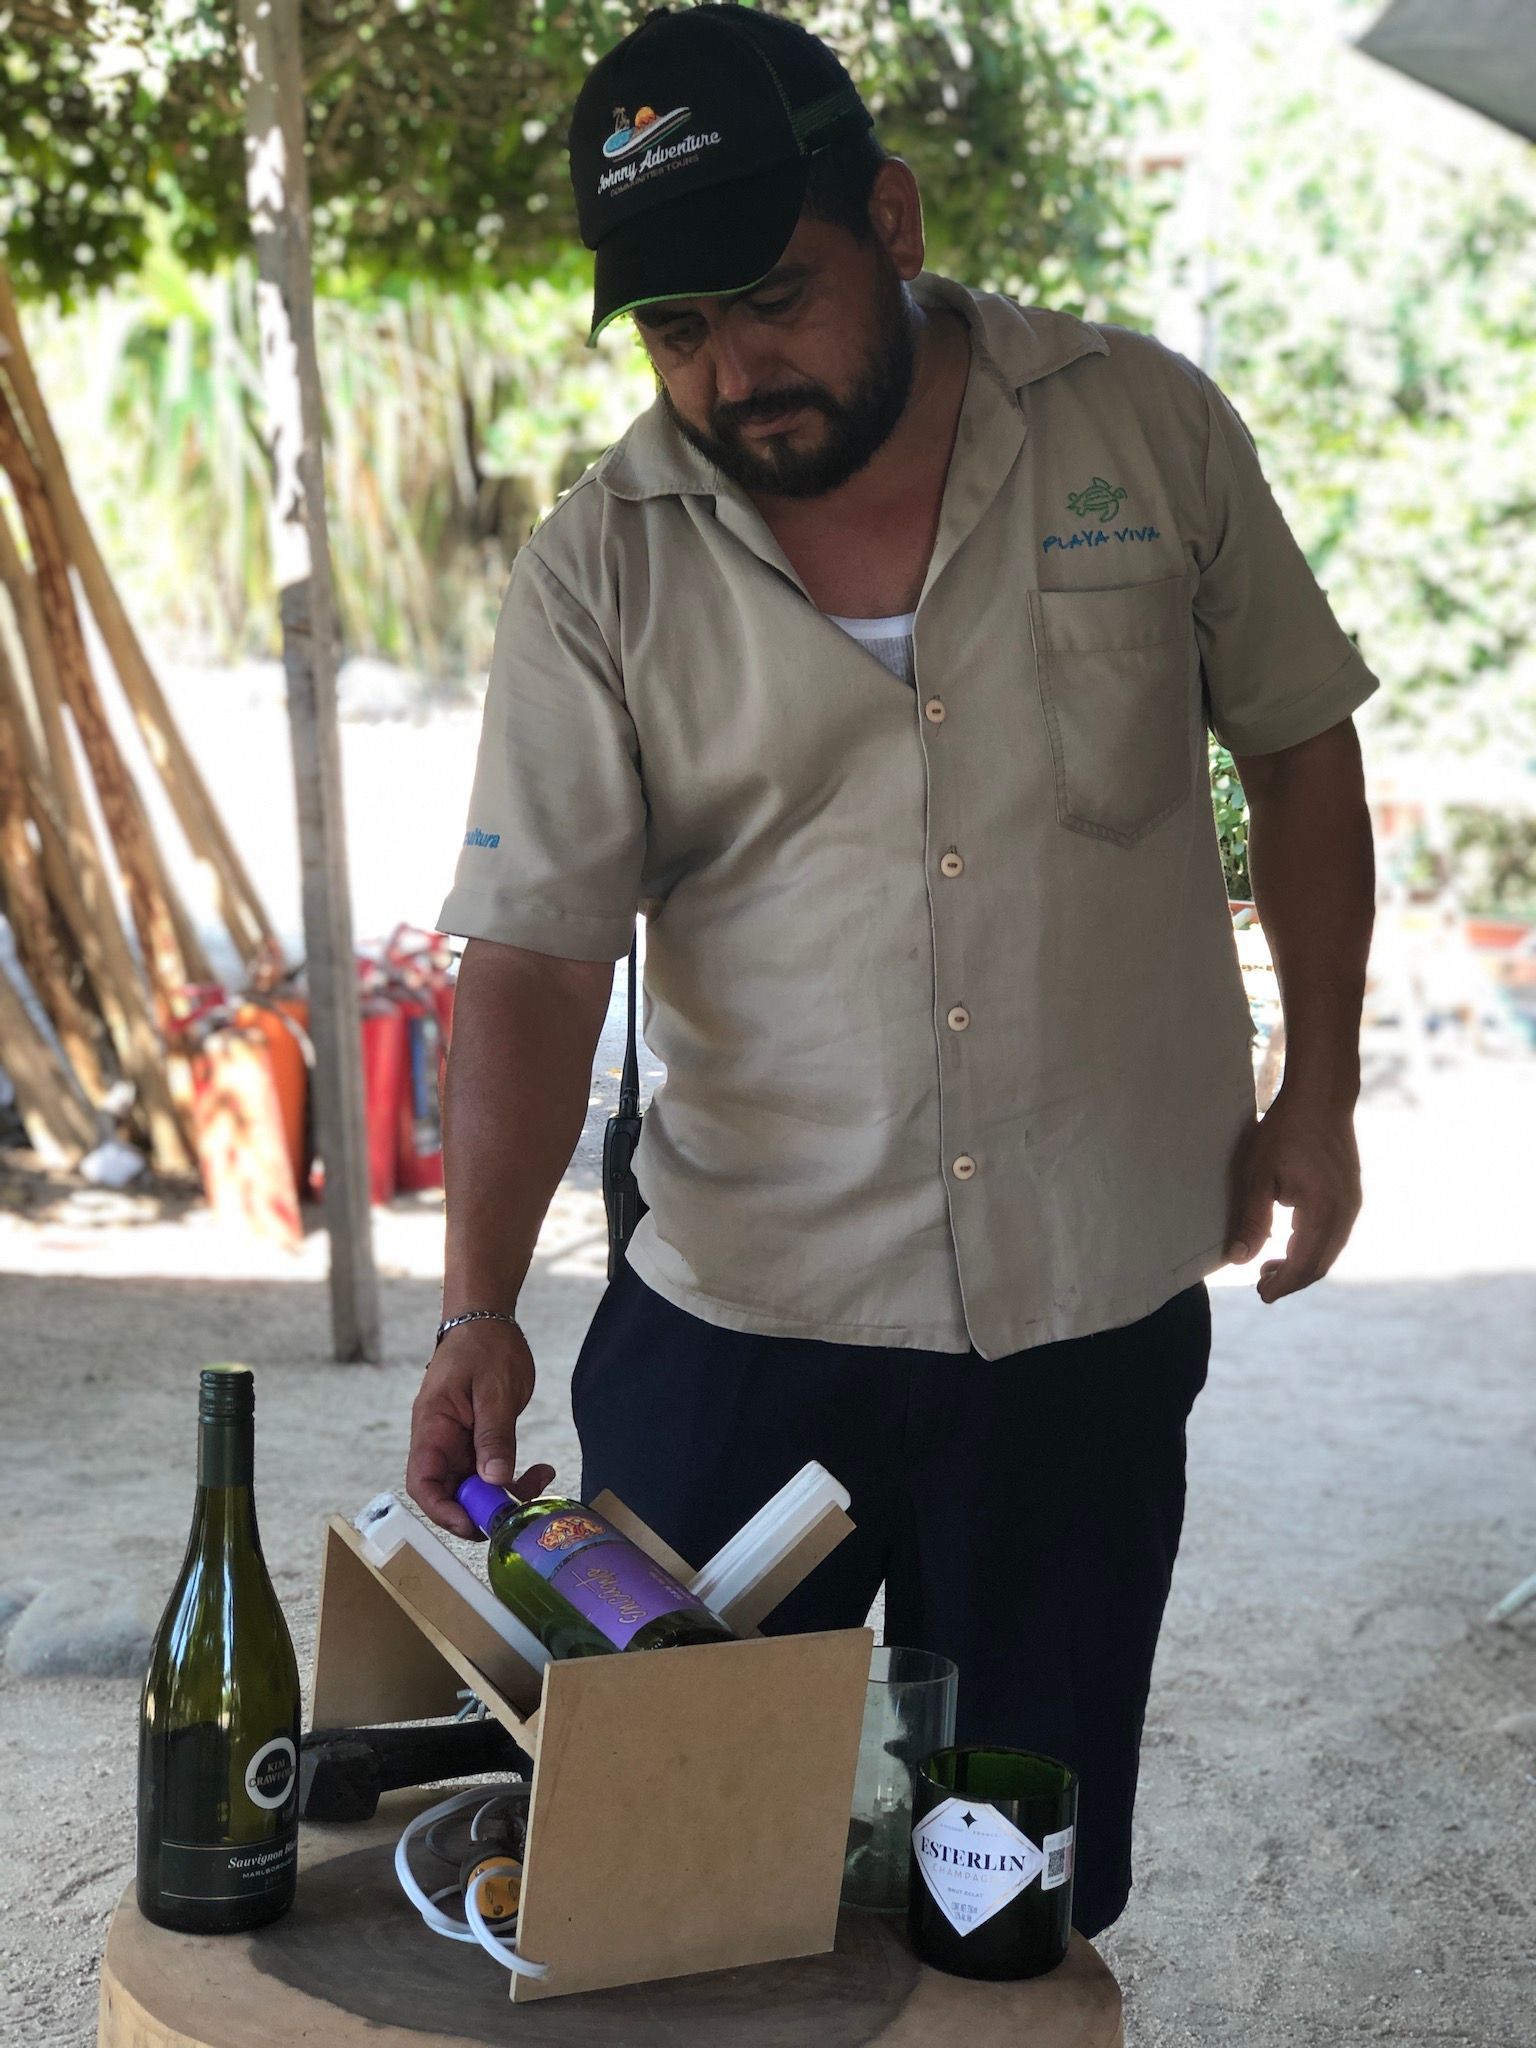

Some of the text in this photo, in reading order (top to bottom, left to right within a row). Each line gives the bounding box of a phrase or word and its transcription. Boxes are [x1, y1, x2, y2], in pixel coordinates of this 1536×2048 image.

[639, 131, 722, 174] Adventure
[1043, 526, 1160, 553] PLAYA VIVA
[227, 1847, 284, 1870] Sauvignon
[921, 1836, 1026, 1872] ESTERLIN
